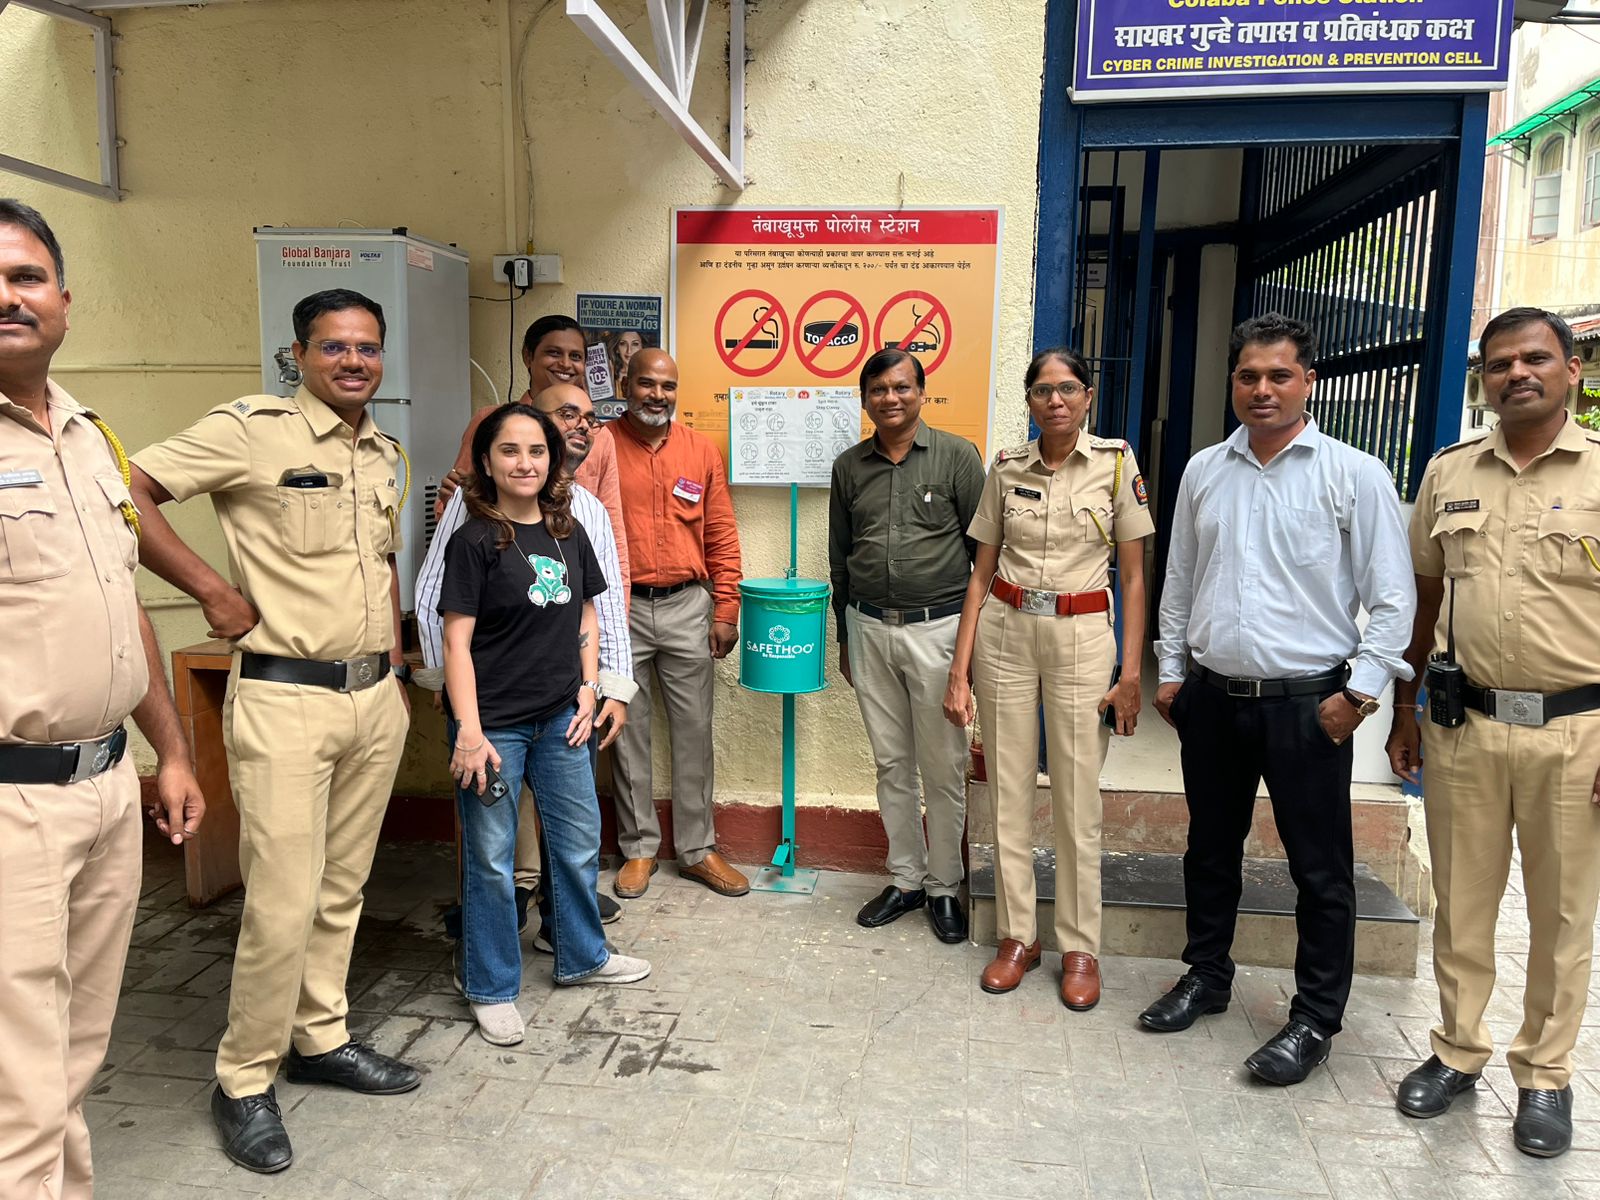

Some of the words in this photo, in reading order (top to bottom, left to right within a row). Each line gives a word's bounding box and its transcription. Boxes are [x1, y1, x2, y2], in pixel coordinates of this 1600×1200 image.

[1114, 24, 1186, 48] सायबर
[1190, 16, 1234, 52] गुन्हे
[1237, 21, 1299, 44] तपास
[1303, 20, 1320, 42] व
[1323, 11, 1422, 42] प्रतिबंधक
[1426, 18, 1475, 41] कक्ष
[1102, 58, 1152, 73] CYBER
[1156, 56, 1204, 70] CRIME
[1208, 54, 1324, 69] INVESTIGATION
[1327, 53, 1339, 66] &
[1343, 52, 1440, 65] PREVENTION
[1444, 51, 1482, 64] CELL
[752, 215, 819, 239] तंबाखूमुक्त
[825, 214, 872, 234] पोलीस
[878, 214, 920, 235] स्टेशन
[282, 246, 311, 258] Global
[314, 246, 351, 260] Banjara
[581, 299, 589, 308] IF
[619, 301, 624, 310] A
[625, 301, 657, 311] WOMAN
[581, 309, 587, 317] IN
[581, 317, 620, 326] IMMEDIATE
[621, 318, 640, 327] HELP
[643, 320, 658, 330] 103
[590, 371, 607, 384] 103
[746, 640, 813, 655] SAFETHOO
